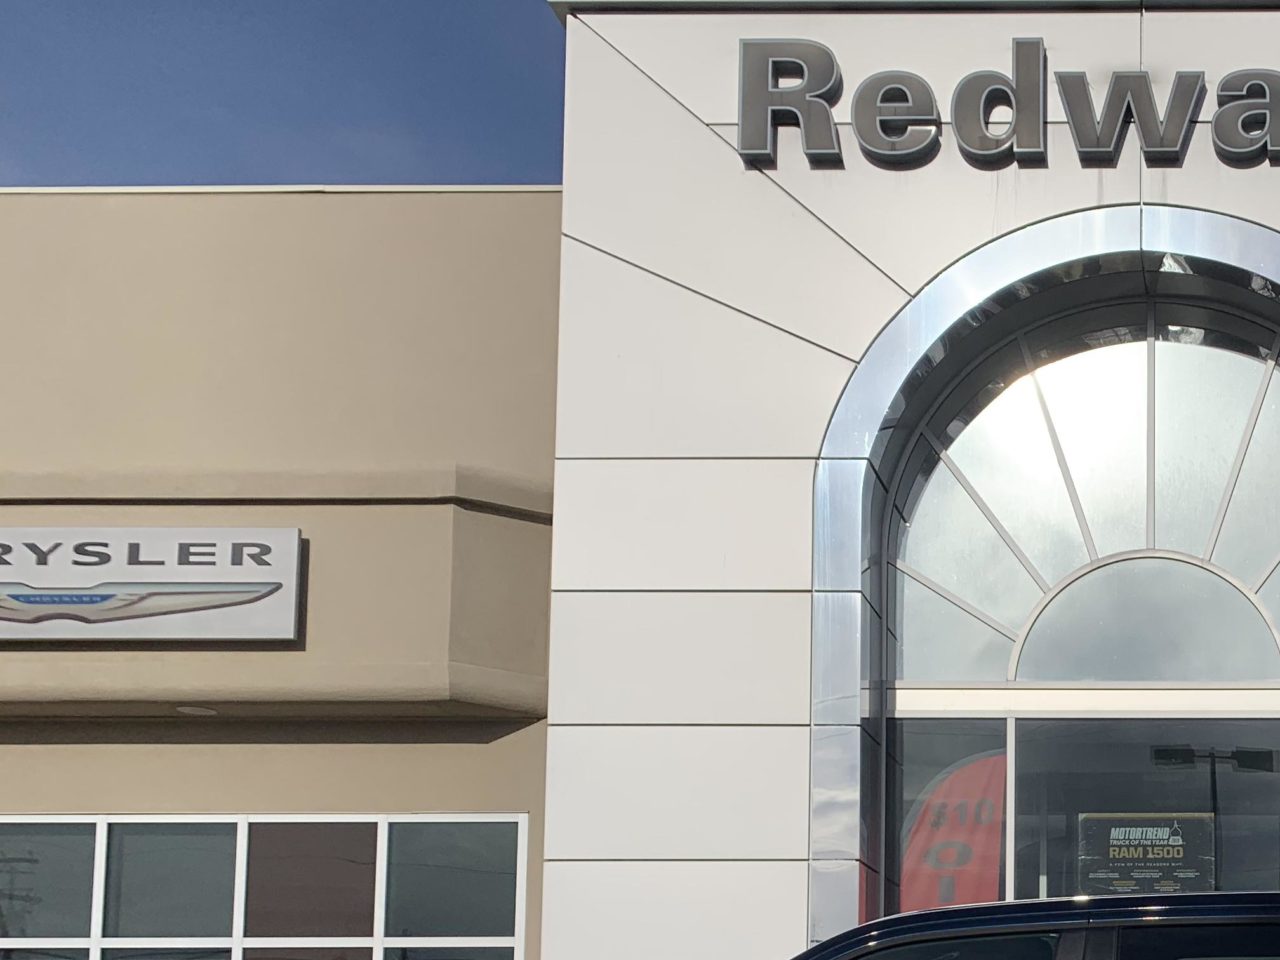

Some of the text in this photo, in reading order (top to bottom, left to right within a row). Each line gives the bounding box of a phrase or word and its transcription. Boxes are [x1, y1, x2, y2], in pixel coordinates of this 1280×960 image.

[929, 798, 995, 832] $10
[1110, 828, 1170, 839] MOTORTREND
[1109, 847, 1183, 858] RAM 1500
